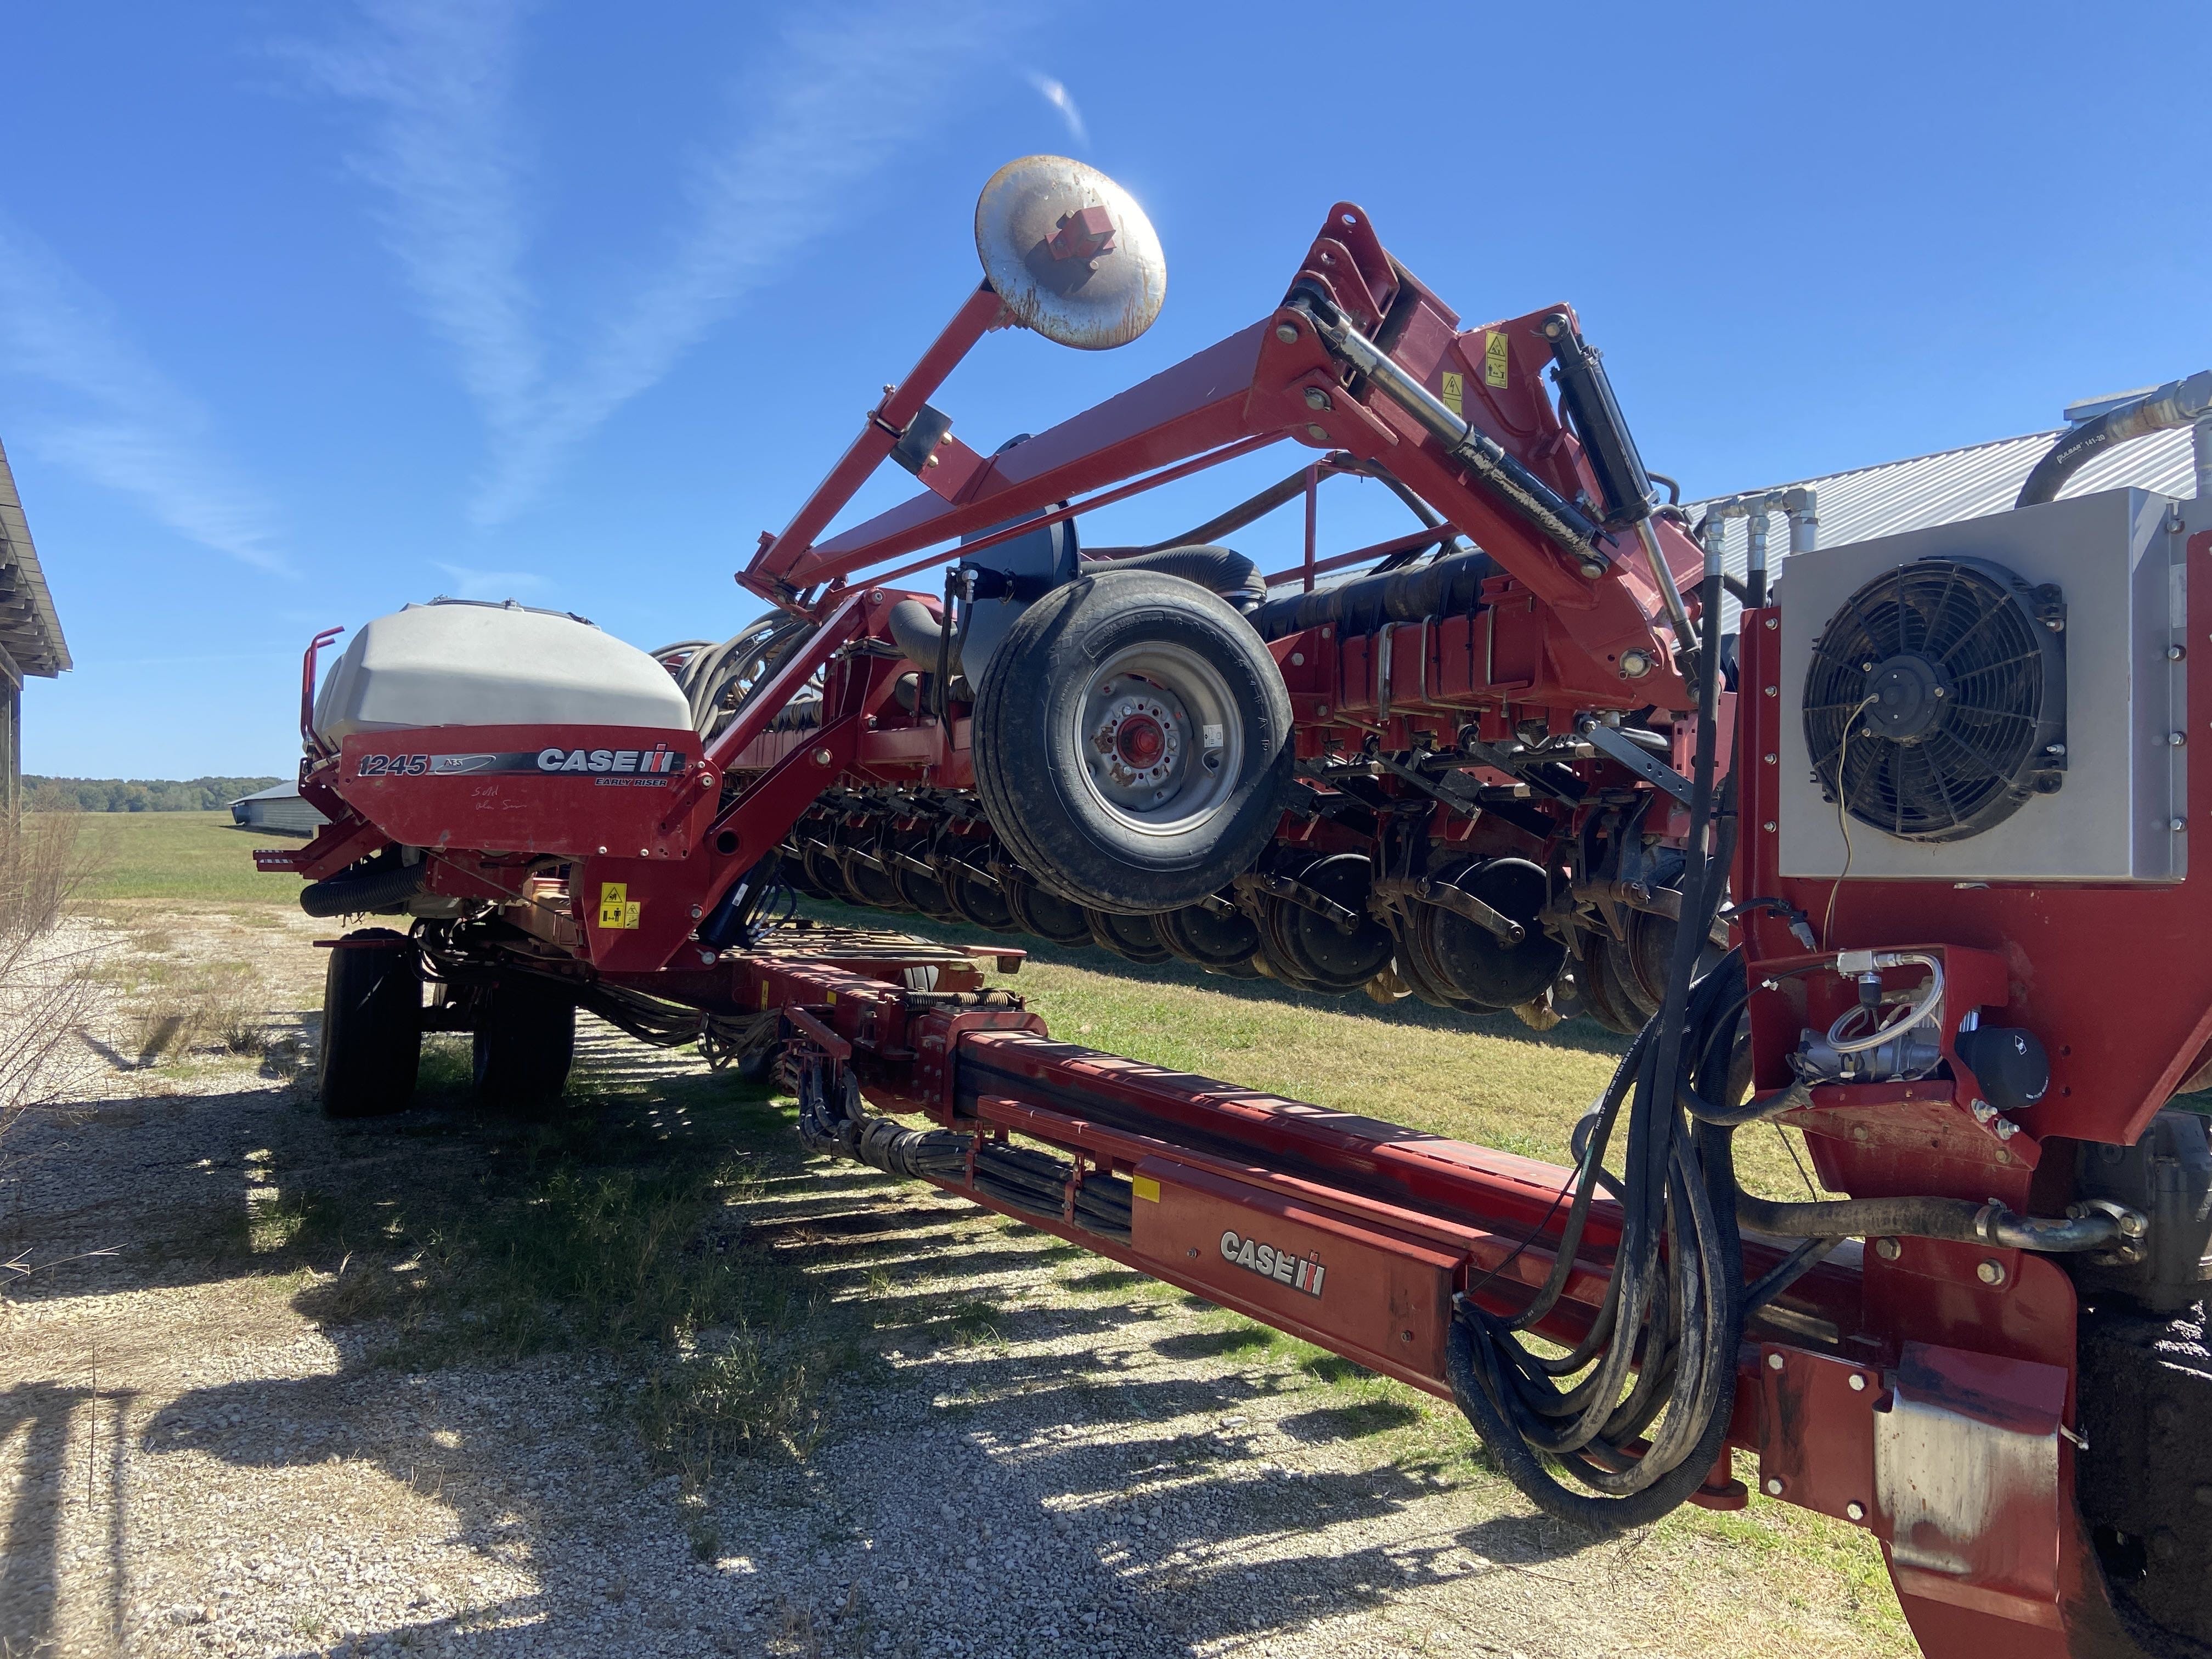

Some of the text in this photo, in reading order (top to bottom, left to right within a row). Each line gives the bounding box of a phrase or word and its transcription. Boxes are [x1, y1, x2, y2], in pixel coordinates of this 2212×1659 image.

[2085, 434, 2106, 447] 141-20
[358, 754, 428, 776] 1245
[443, 758, 463, 767] AFS
